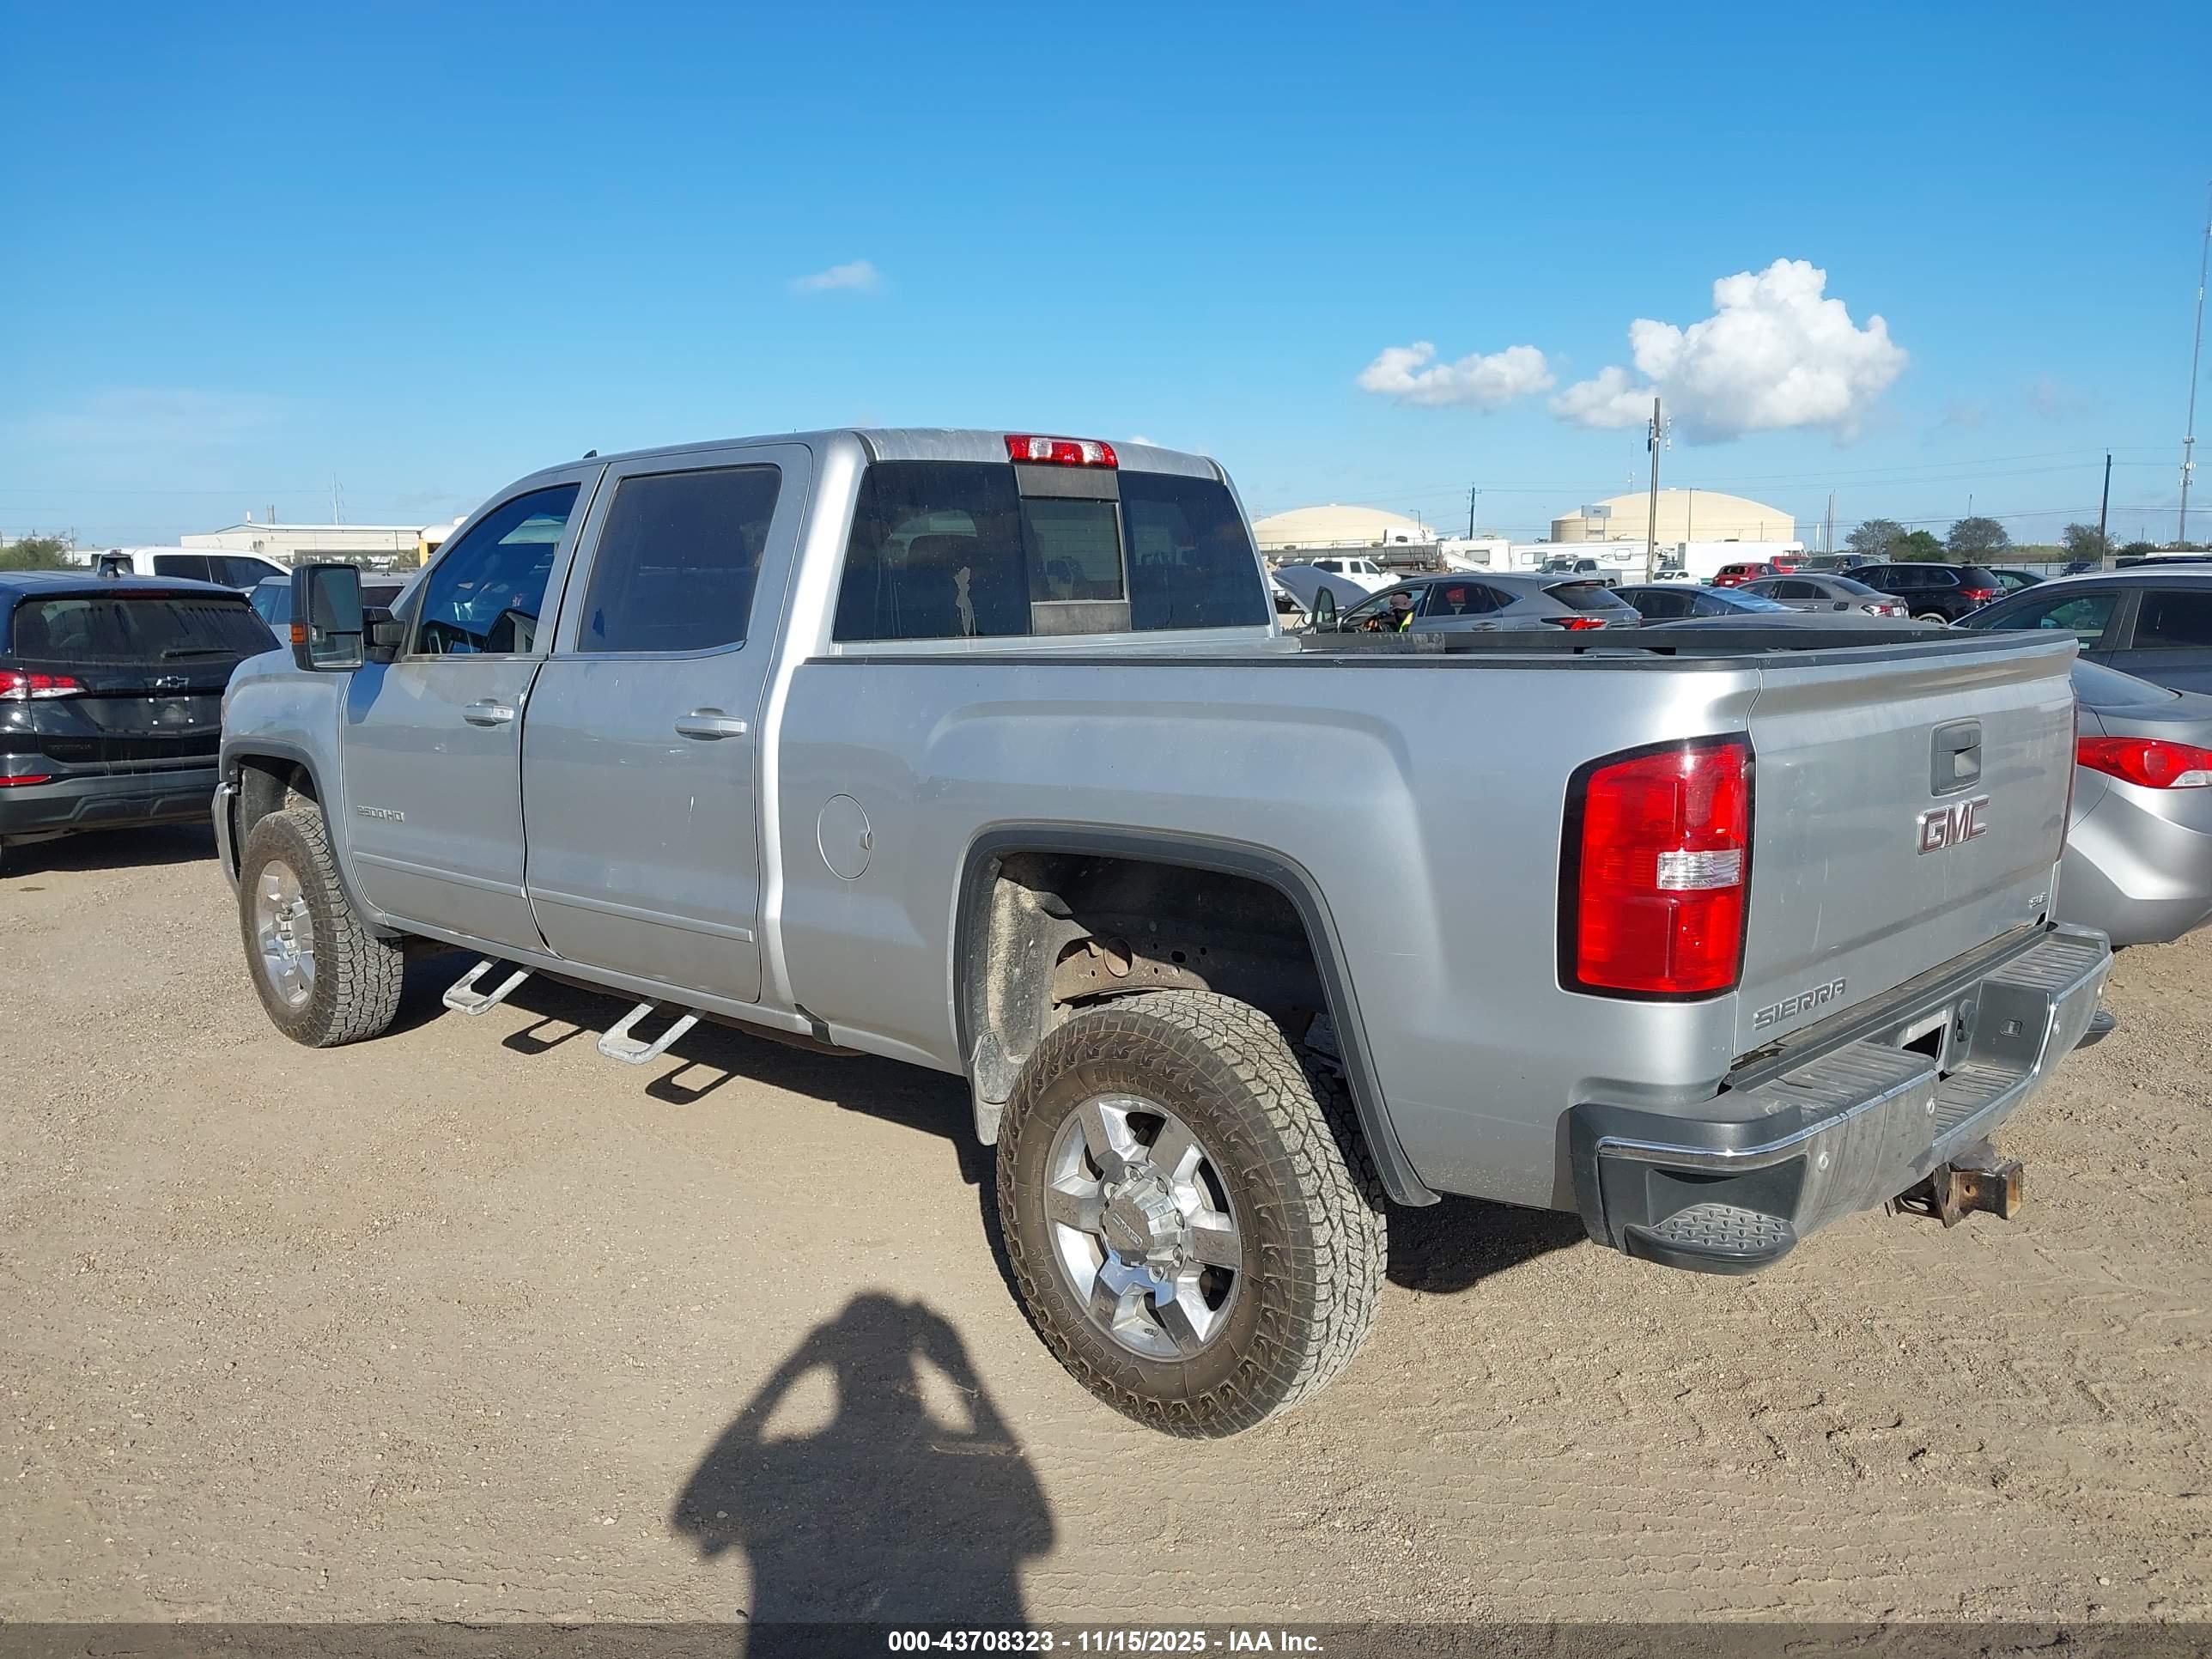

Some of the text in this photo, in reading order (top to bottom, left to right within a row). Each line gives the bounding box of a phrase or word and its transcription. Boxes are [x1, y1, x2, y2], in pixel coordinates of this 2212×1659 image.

[1917, 794, 1990, 856] GMC
[1753, 976, 1847, 1030] SIERRA
[1112, 1212, 1144, 1249] GMC
